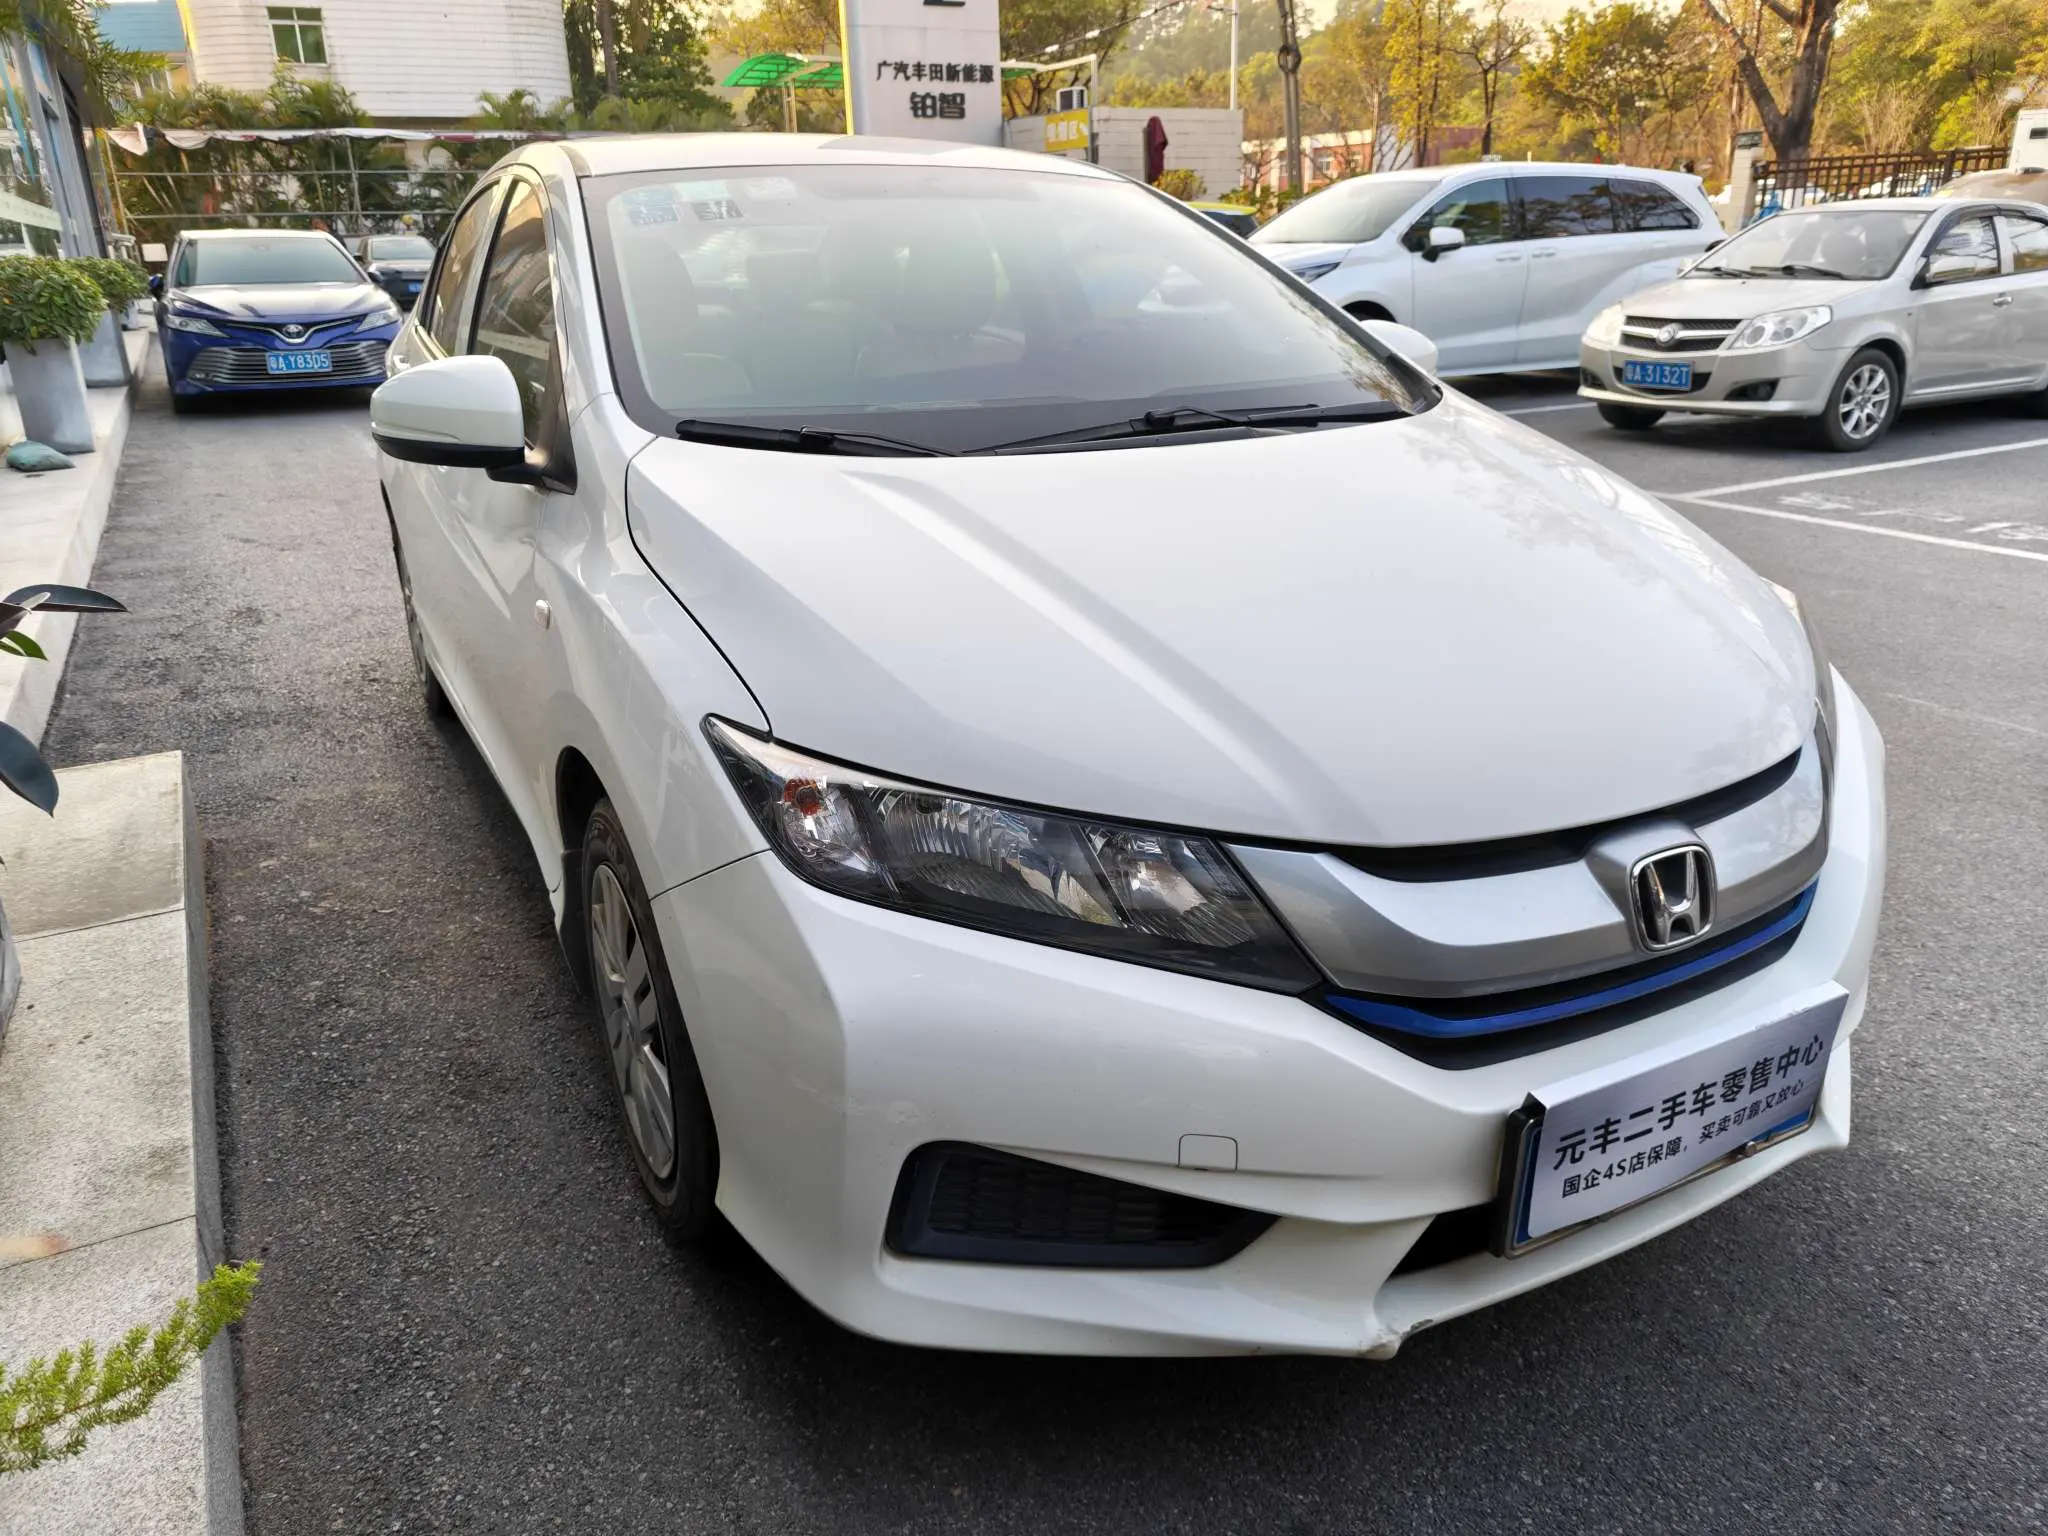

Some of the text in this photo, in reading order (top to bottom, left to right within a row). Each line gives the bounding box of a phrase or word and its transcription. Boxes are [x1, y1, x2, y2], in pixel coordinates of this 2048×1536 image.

[876, 60, 995, 83] 广汽丰田新能源
[910, 91, 966, 119] 铂智
[1552, 1034, 1824, 1170] 元丰二手车零售中心
